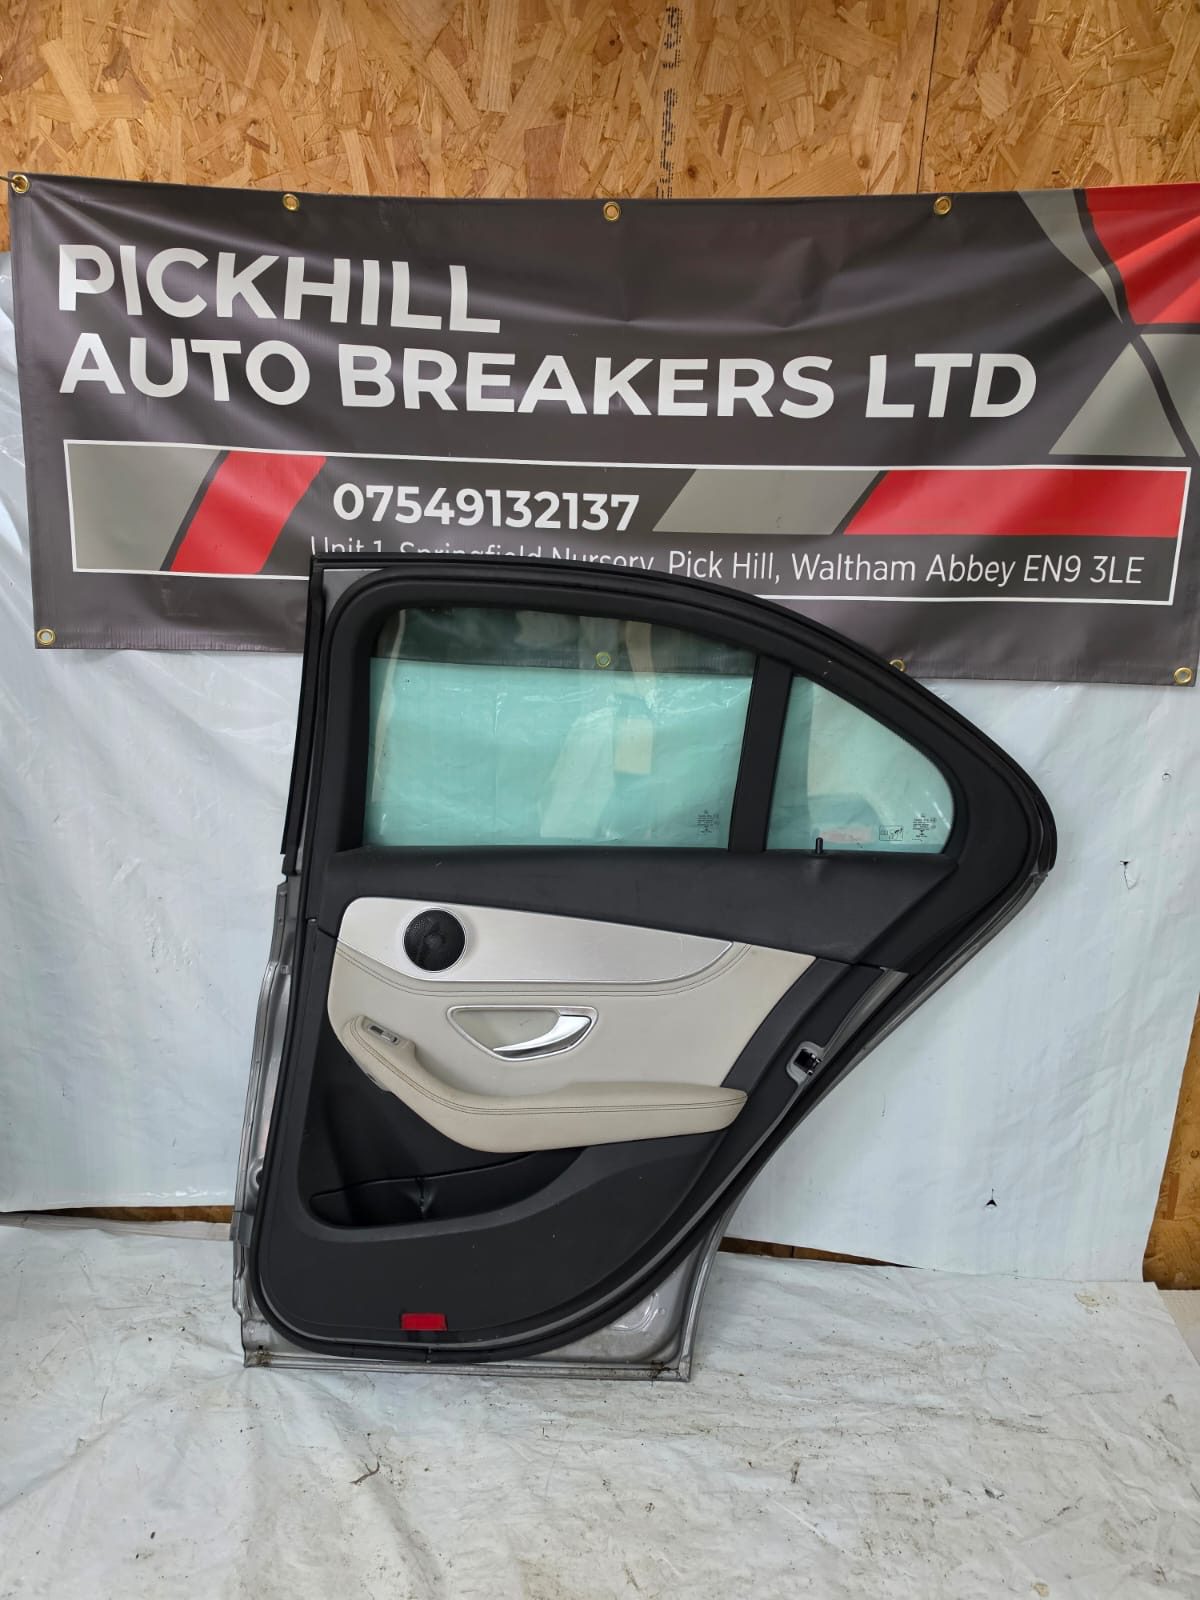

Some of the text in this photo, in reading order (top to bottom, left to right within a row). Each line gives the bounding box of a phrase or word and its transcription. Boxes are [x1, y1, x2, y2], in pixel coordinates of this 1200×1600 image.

[58, 243, 500, 334] PICKHILL
[59, 332, 1037, 419] AUTO BREAKERS LTD
[333, 482, 640, 532] 07549132137
[669, 550, 723, 578] Pick
[732, 552, 780, 584] Hill,
[791, 553, 916, 582] Waltham
[925, 554, 1016, 587] Abbey
[1023, 554, 1081, 583] EN9
[1090, 555, 1145, 584] 3LE
